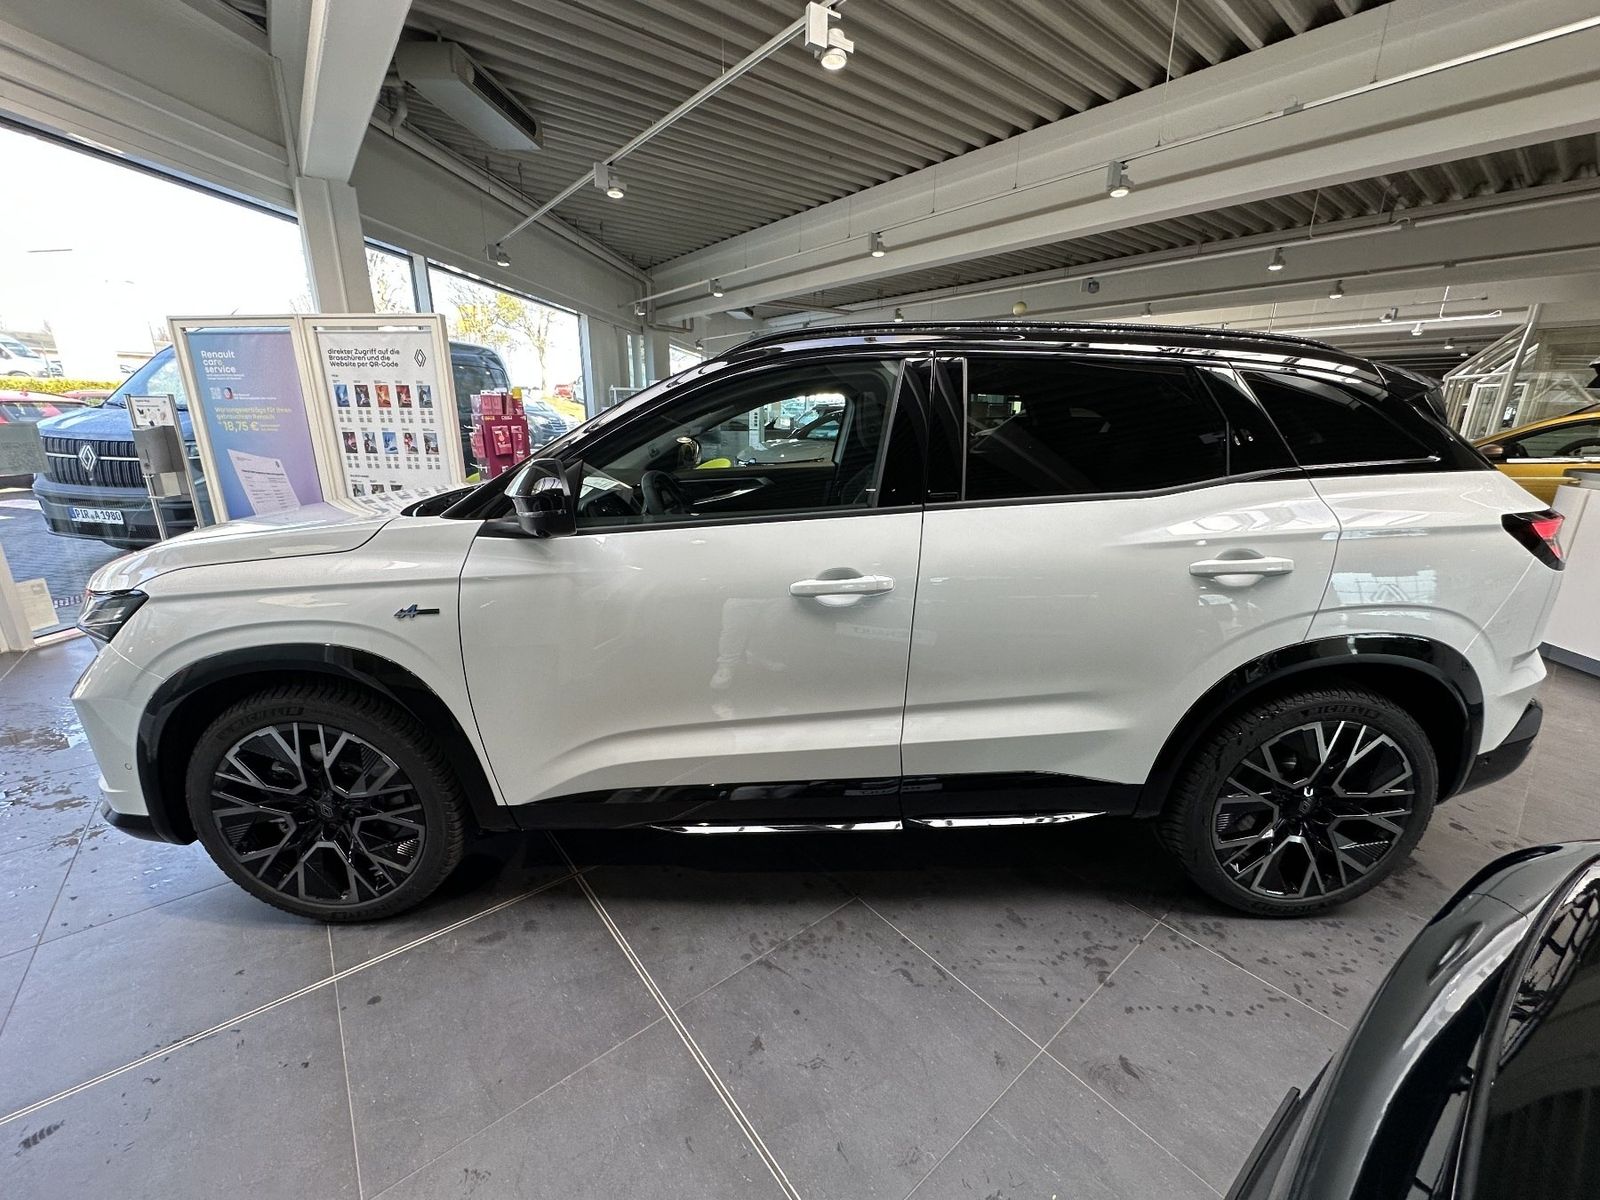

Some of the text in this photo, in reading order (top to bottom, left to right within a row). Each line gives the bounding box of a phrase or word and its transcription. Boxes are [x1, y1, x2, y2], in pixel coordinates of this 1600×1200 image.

[200, 350, 236, 359] Renault
[354, 348, 376, 356] Zugriff
[204, 366, 236, 374] service
[223, 420, 249, 433] 18,75
[250, 421, 260, 432] €
[74, 508, 122, 521] PIR A 1980
